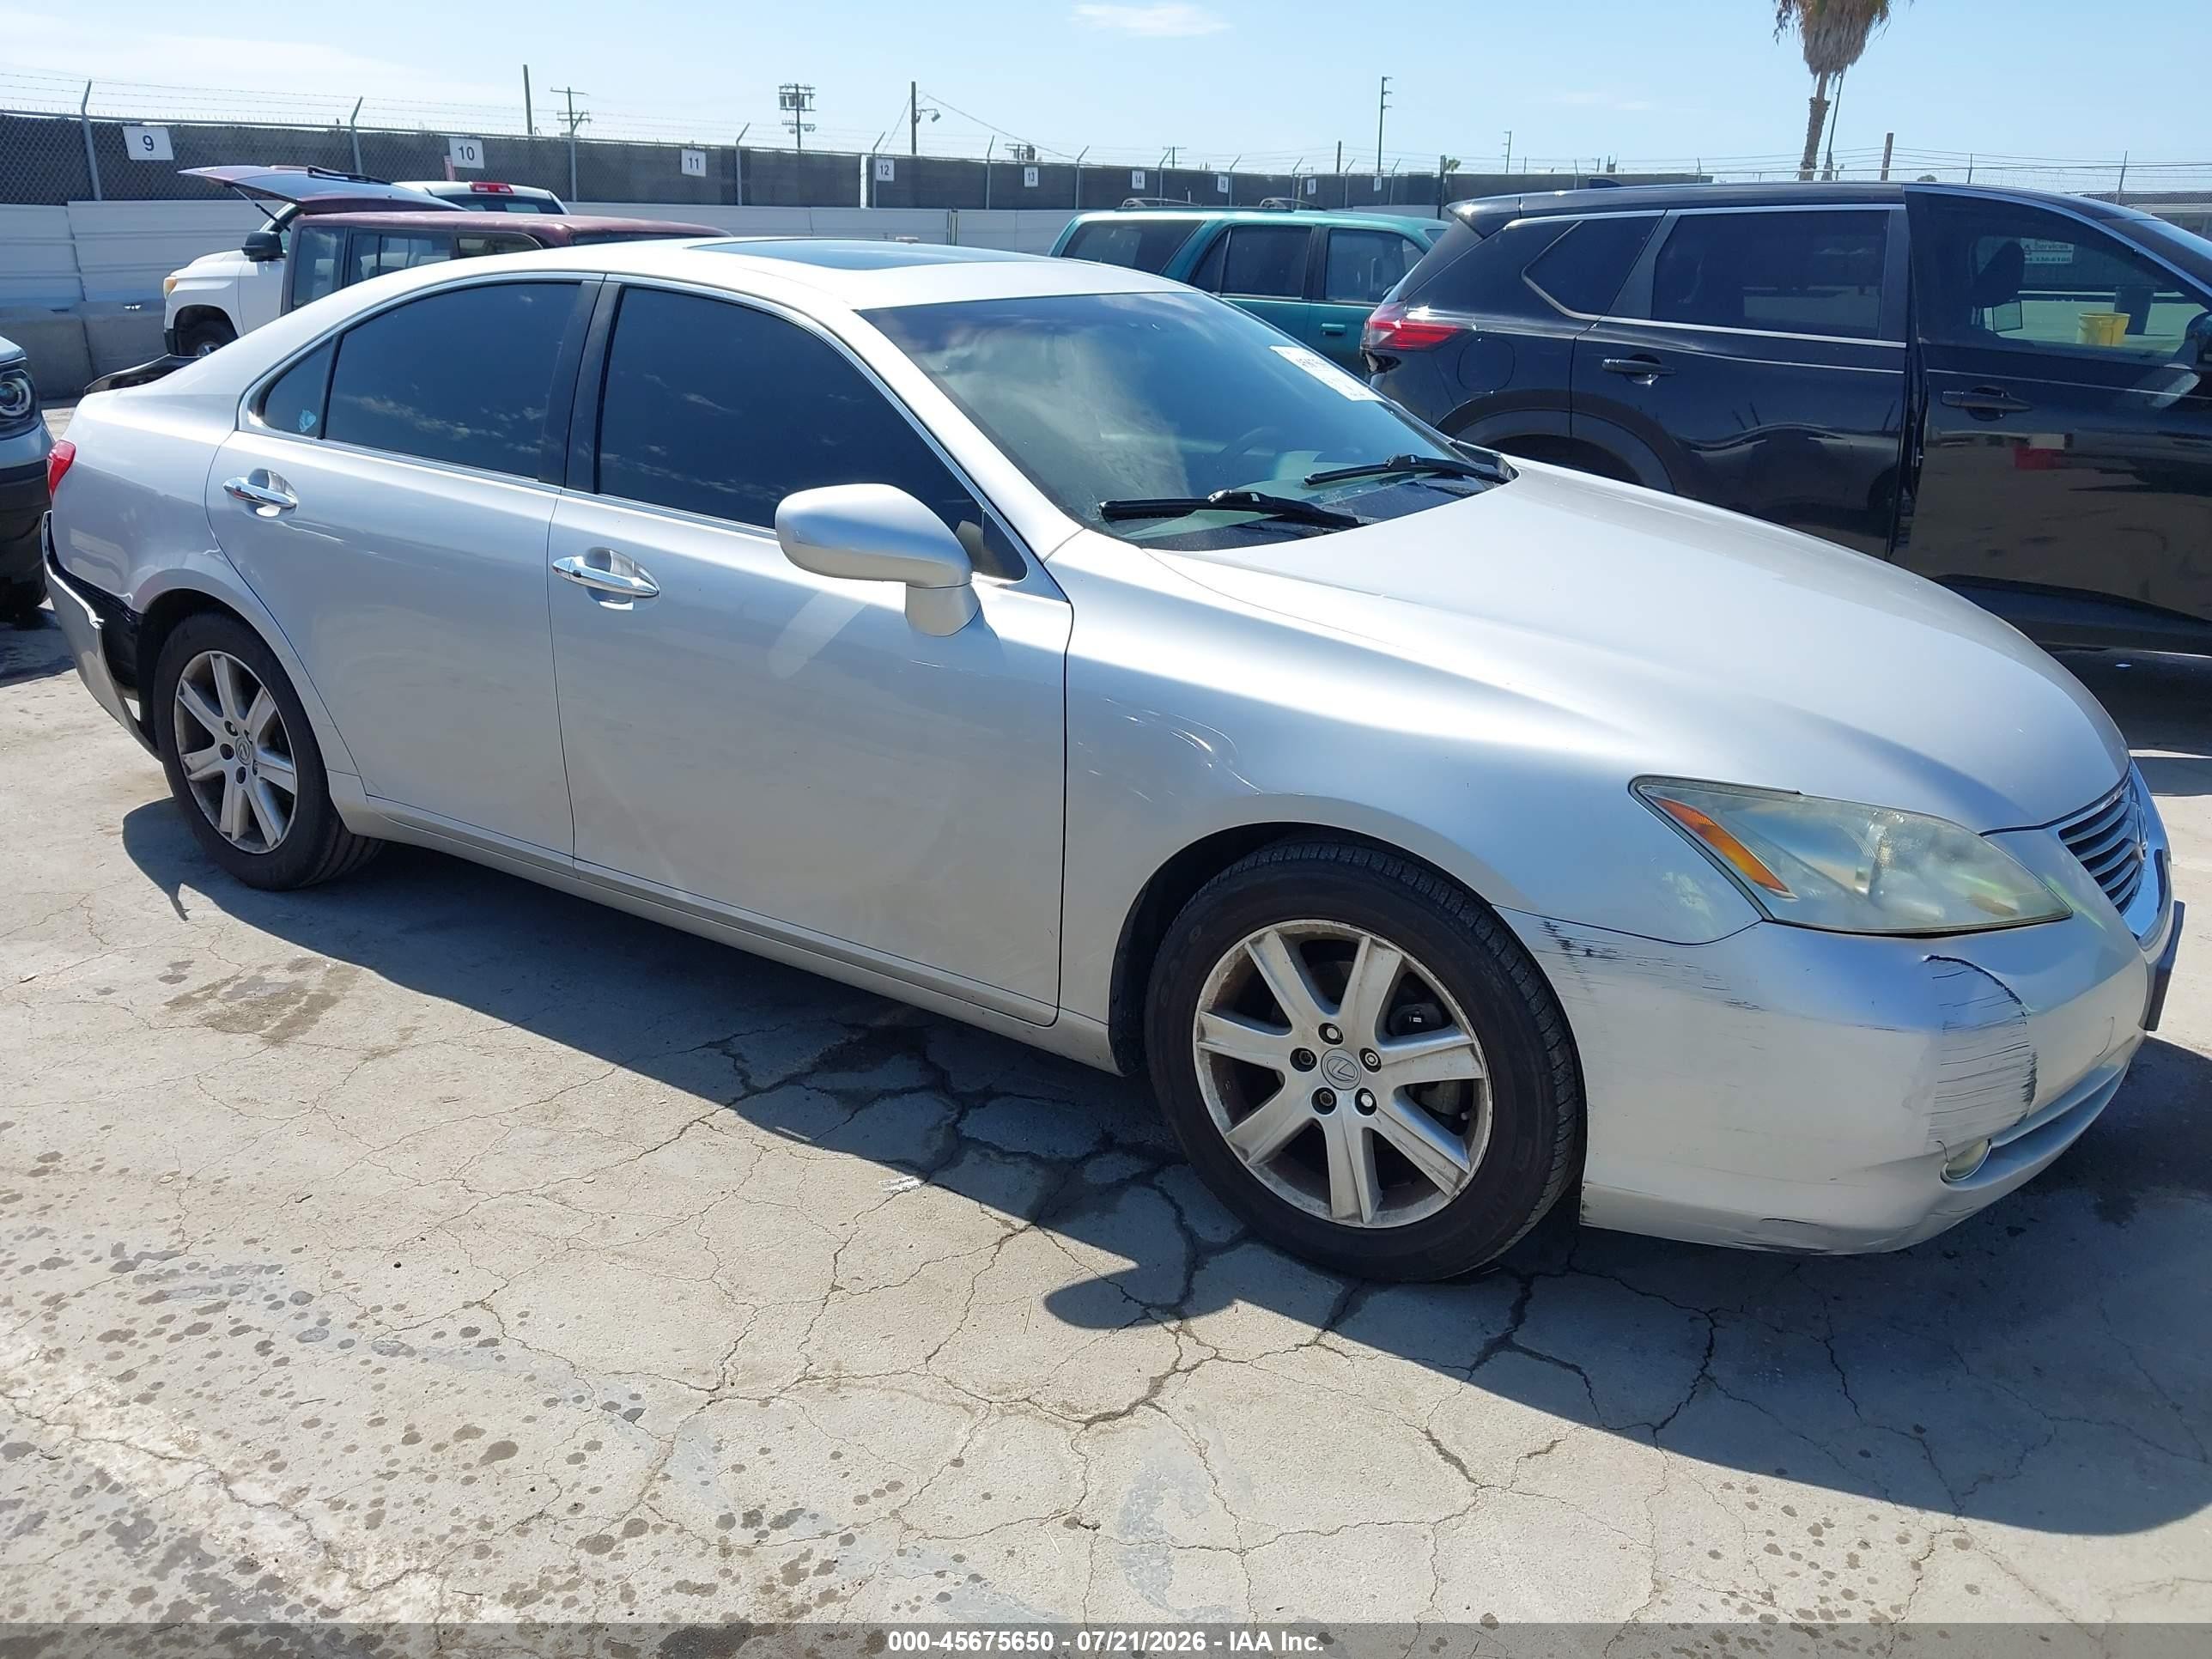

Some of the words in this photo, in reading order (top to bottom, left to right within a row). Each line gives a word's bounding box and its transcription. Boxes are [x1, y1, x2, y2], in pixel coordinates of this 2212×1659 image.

[143, 135, 155, 151] 9
[459, 146, 475, 161] 10
[689, 157, 699, 170] 11
[879, 164, 890, 176] 12
